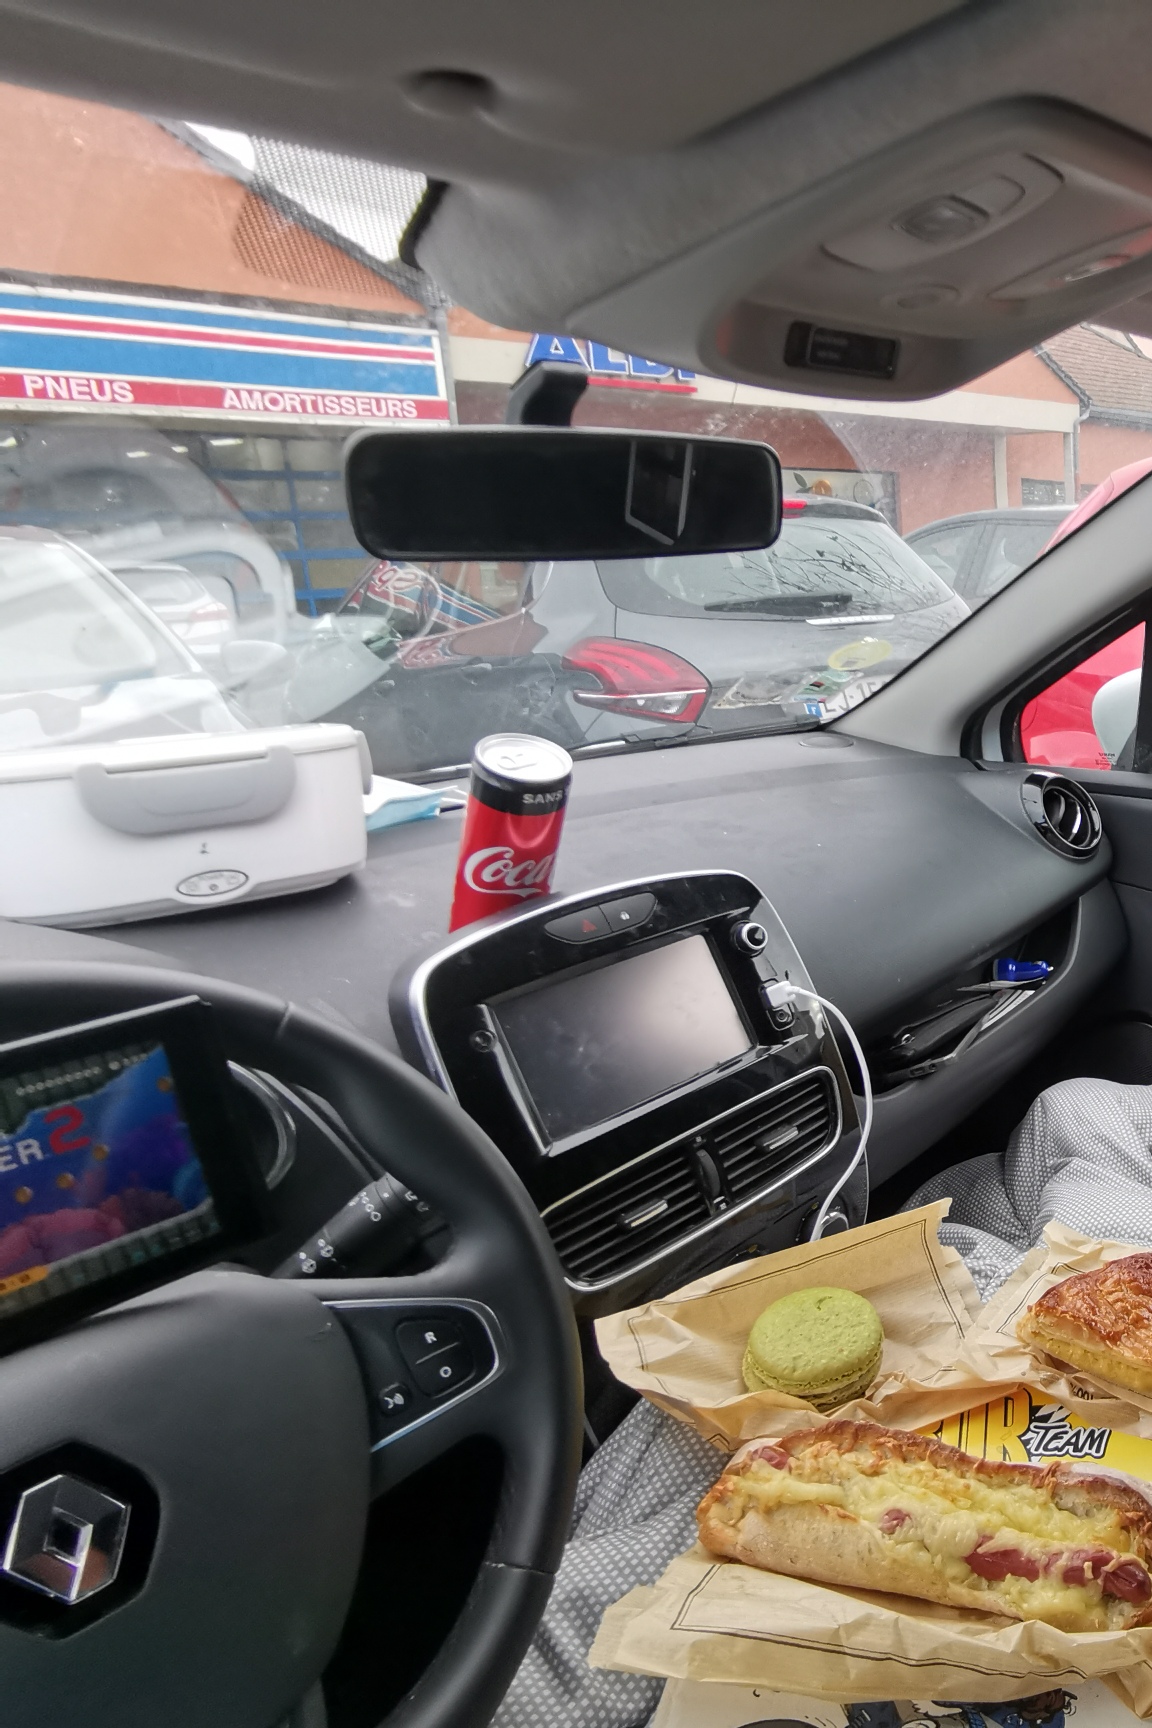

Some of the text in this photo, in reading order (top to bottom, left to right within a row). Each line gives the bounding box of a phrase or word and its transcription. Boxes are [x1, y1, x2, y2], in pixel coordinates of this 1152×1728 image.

[525, 332, 696, 381] AL
[22, 374, 135, 404] PNEUS
[222, 388, 418, 418] AMORTISSEURS
[424, 1331, 437, 1344] R
